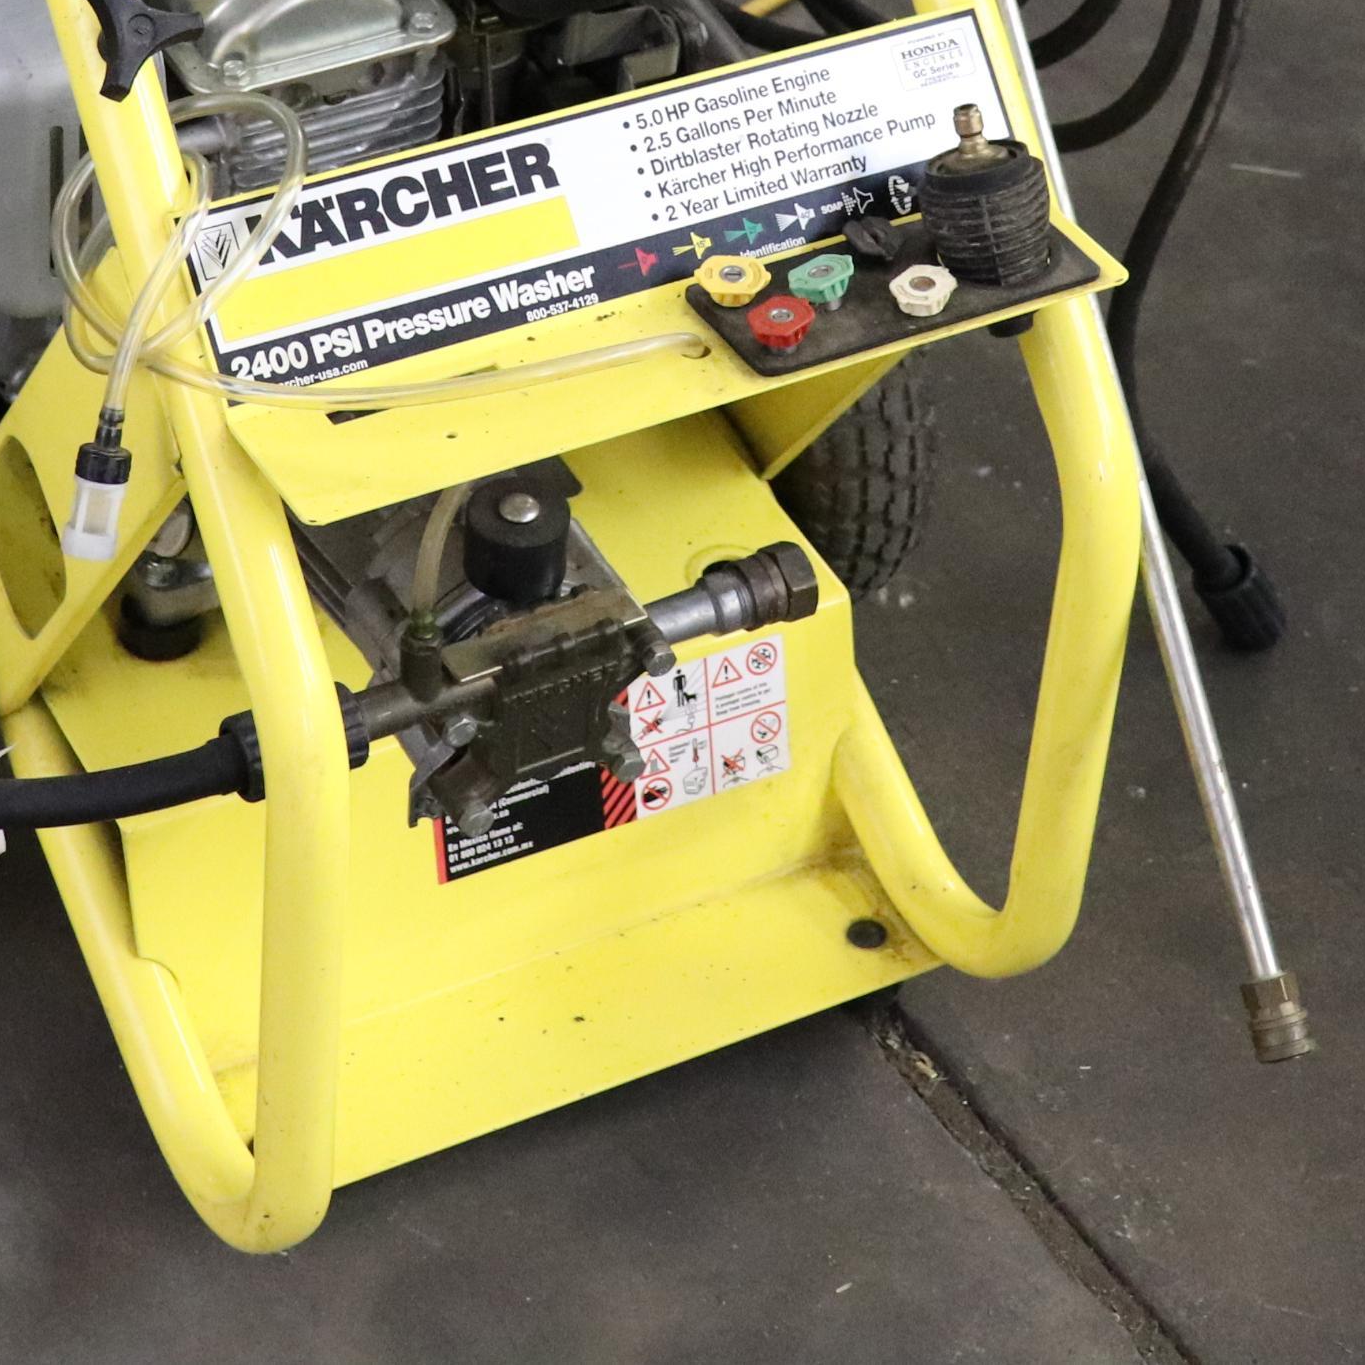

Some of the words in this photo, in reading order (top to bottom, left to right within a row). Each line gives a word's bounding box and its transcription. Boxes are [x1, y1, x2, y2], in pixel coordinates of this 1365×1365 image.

[900, 38, 959, 60] HONDA
[913, 68, 928, 79] GC
[929, 61, 961, 75] Series
[635, 109, 664, 130] 5.0
[665, 101, 690, 123] HP
[694, 82, 769, 113] Gasoline
[771, 67, 832, 94] Engine
[643, 132, 673, 153] 2.5
[676, 113, 741, 142] Gallons
[743, 108, 774, 126] Per
[776, 89, 838, 118] Minute
[650, 139, 741, 176] Dirtblaster
[747, 118, 821, 150] Rotating
[822, 102, 879, 129] Nozzle
[657, 168, 727, 199] Kärcher
[731, 156, 772, 180] High
[774, 128, 884, 167] Performance
[886, 111, 937, 136] Pump
[665, 205, 678, 222] 2
[679, 196, 720, 218] Year
[723, 176, 789, 206] Limited
[790, 154, 868, 186] Warranty
[821, 201, 843, 215] SOAP
[739, 236, 807, 259] Identification
[230, 340, 309, 382] 2400
[310, 324, 363, 365] PSI
[362, 292, 492, 350] Pressure
[487, 264, 597, 313] Washer
[525, 292, 599, 323] 800-537-4129
